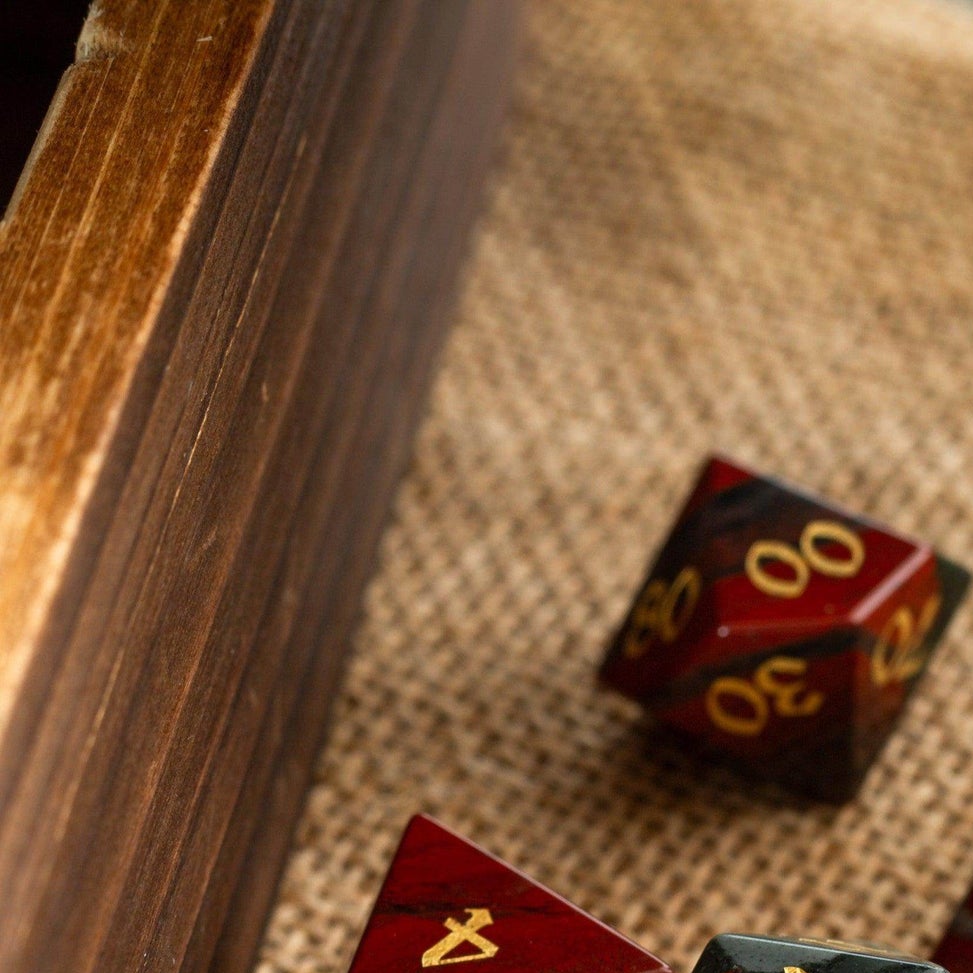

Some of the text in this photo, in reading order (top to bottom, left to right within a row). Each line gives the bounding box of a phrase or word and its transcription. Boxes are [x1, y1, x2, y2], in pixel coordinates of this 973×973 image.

[744, 520, 866, 598] 00
[705, 656, 824, 736] 30
[422, 908, 499, 968] 4
